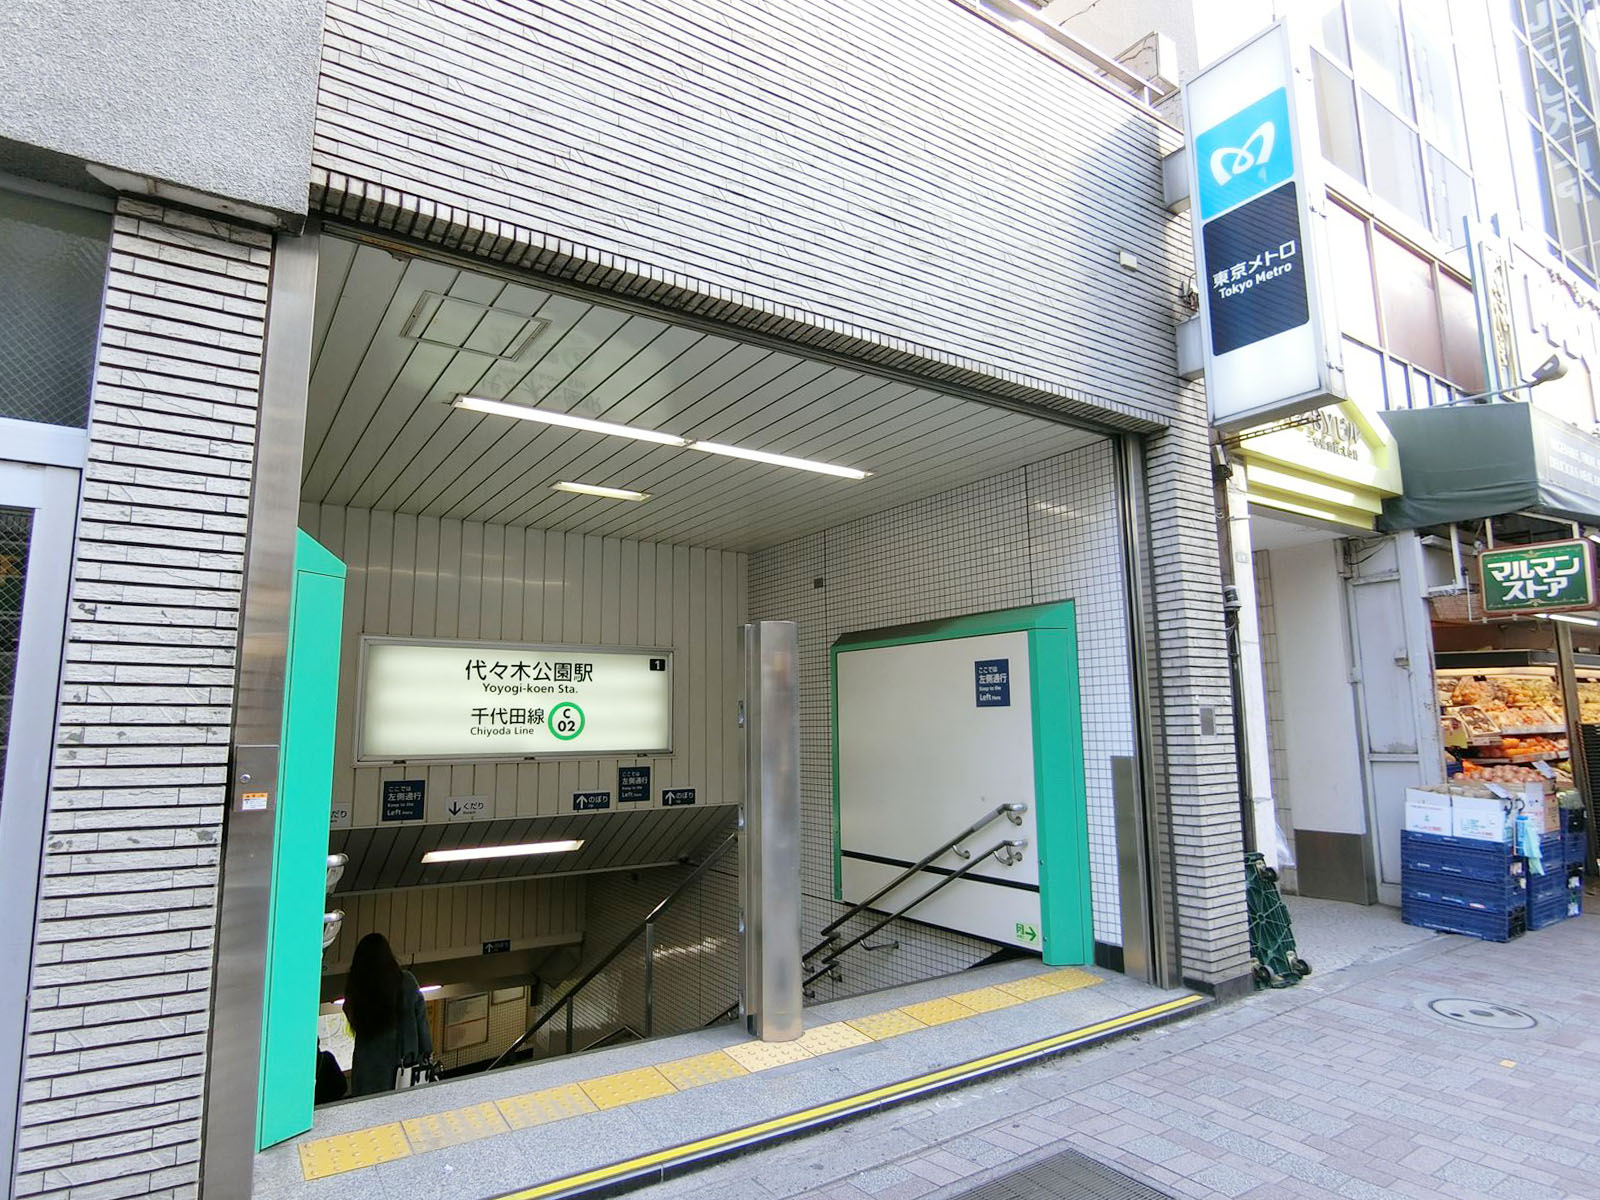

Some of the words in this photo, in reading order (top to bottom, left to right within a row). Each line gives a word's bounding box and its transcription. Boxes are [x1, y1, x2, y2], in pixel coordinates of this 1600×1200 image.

[1213, 239, 1296, 289] 東京メトロ
[1218, 279, 1253, 299] Tokyo
[1255, 263, 1292, 285] Metro
[1487, 554, 1580, 581] マルマン
[1502, 576, 1568, 601] ストア
[465, 659, 593, 683] 代々木公園駅
[482, 683, 554, 695] Yoyogi-koen
[558, 684, 578, 694] Sta.
[979, 693, 991, 701] Left
[471, 707, 545, 725] 千代田線
[563, 708, 571, 719] C
[470, 726, 511, 737] Chiyoda
[514, 726, 535, 735] Line
[557, 720, 576, 732] 02
[387, 792, 422, 801] 左側通行
[588, 794, 608, 803] のぼり
[463, 801, 484, 810] くだり
[387, 808, 401, 816] Left
